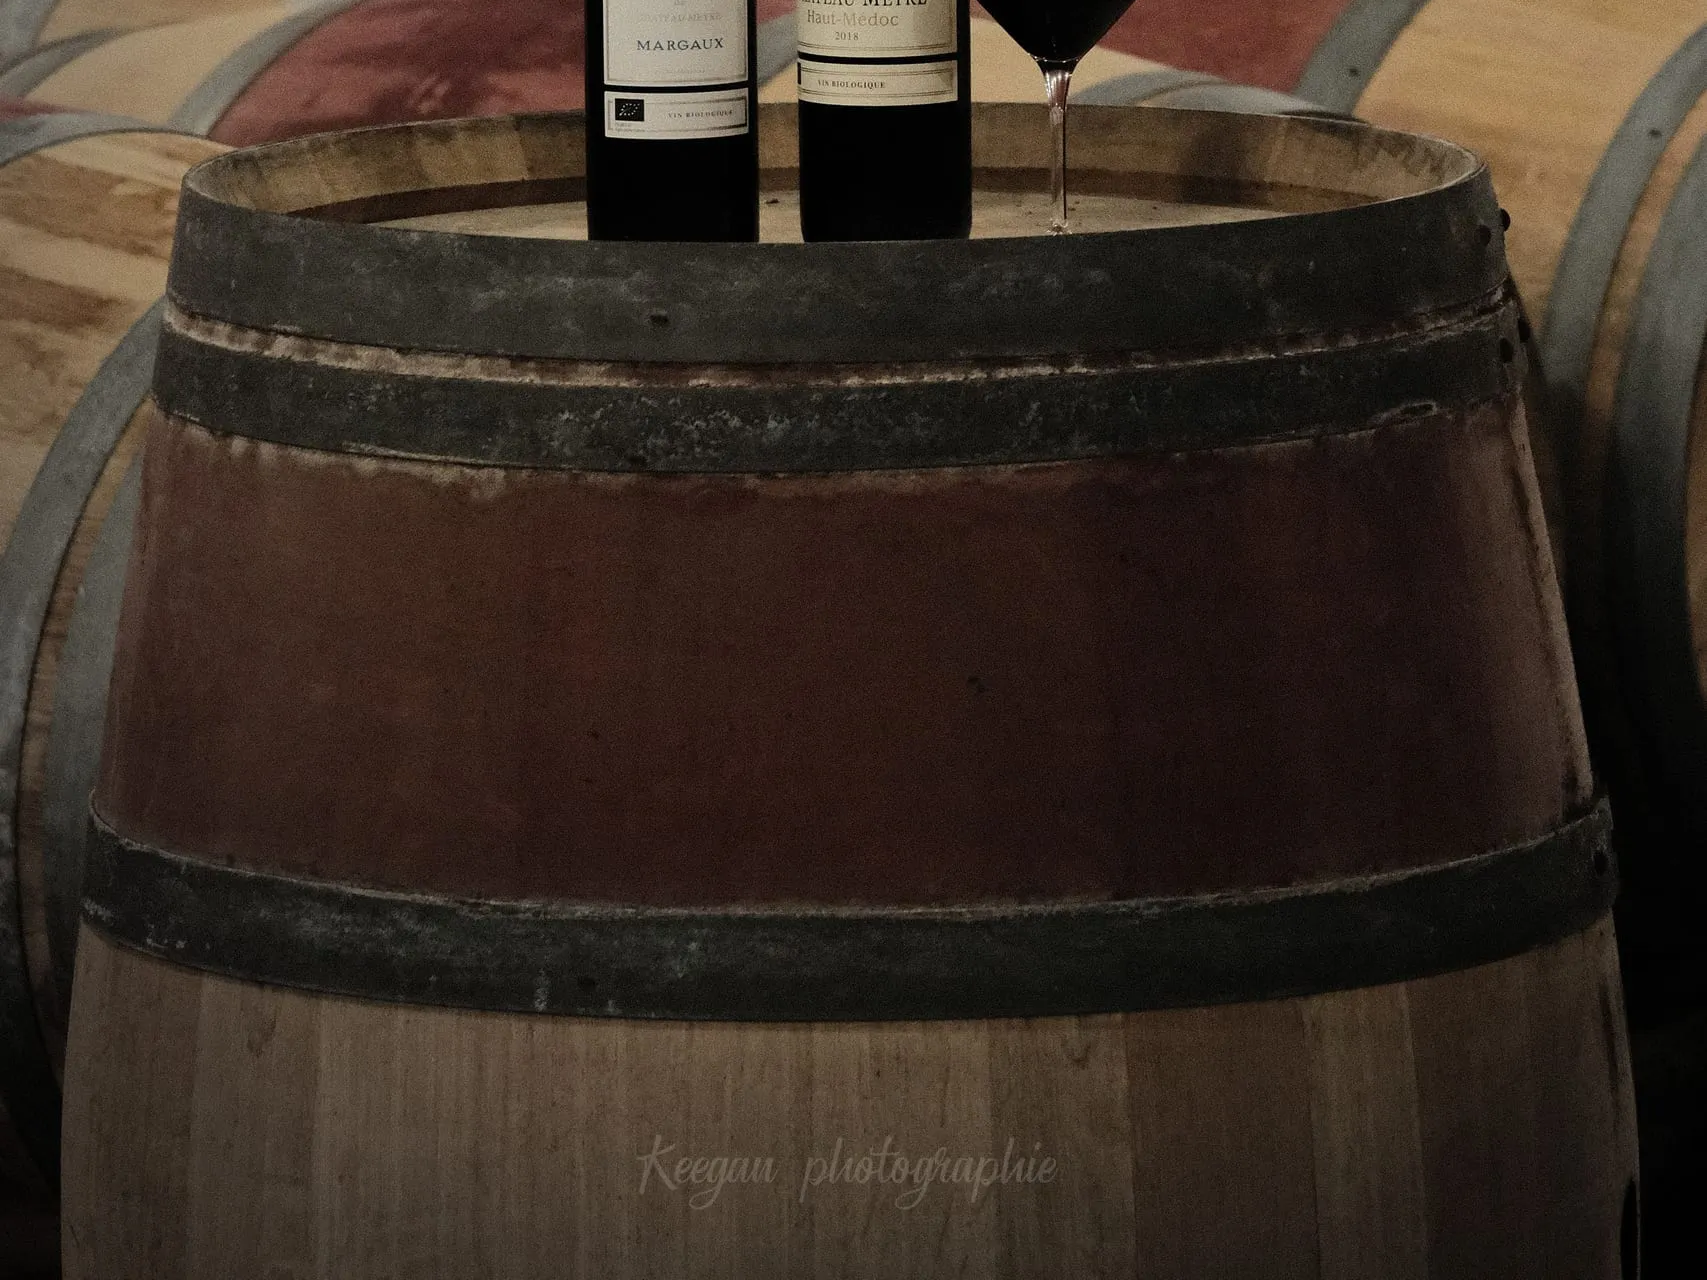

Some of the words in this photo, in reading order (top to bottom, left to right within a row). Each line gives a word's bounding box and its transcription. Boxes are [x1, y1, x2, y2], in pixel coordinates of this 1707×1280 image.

[807, 9, 900, 27] Haut-Médoc
[835, 31, 859, 41] 2018
[636, 37, 724, 52] MARGAUX
[818, 79, 830, 87] VIN
[832, 80, 886, 90] BIOLOGIQUE
[686, 109, 733, 118] BIOLOGIQUE
